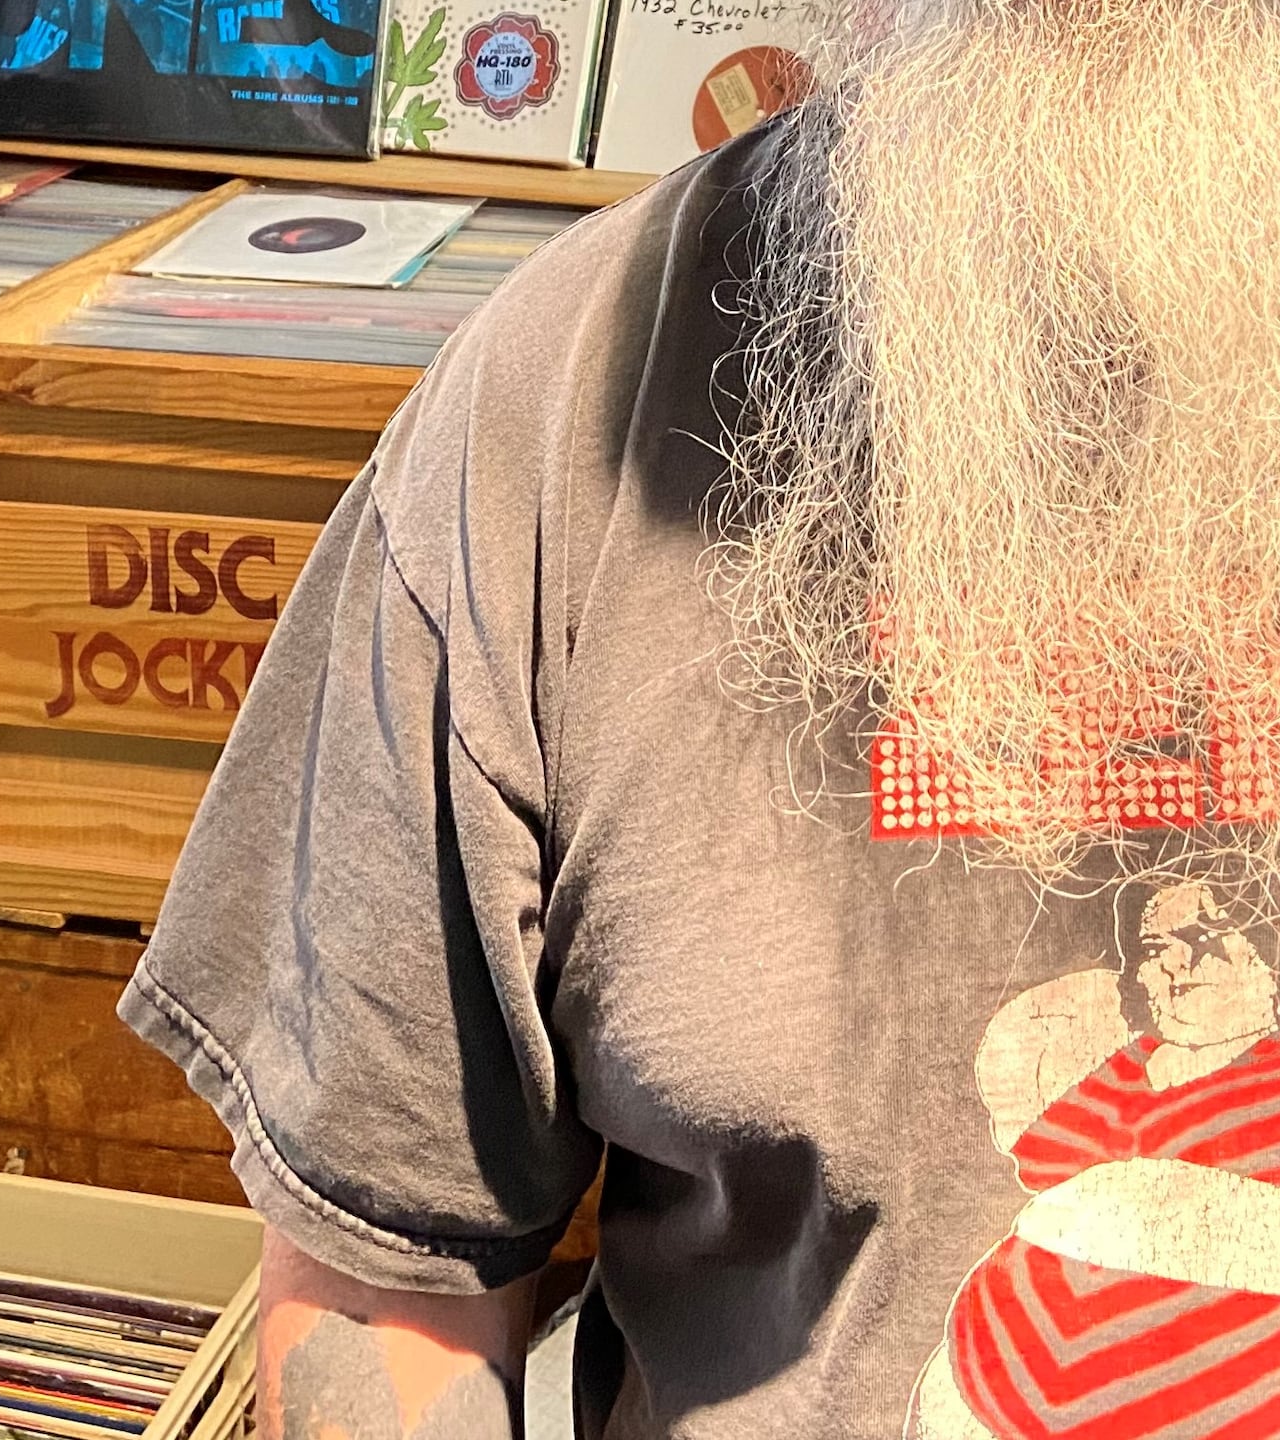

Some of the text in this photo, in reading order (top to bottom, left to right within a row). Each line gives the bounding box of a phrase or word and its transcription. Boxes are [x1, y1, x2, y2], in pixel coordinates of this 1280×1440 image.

[475, 54, 533, 70] HQ-180
[231, 89, 325, 104] THE SIRE ALBUMS
[86, 523, 280, 621] DISC
[44, 630, 272, 720] JOCK
